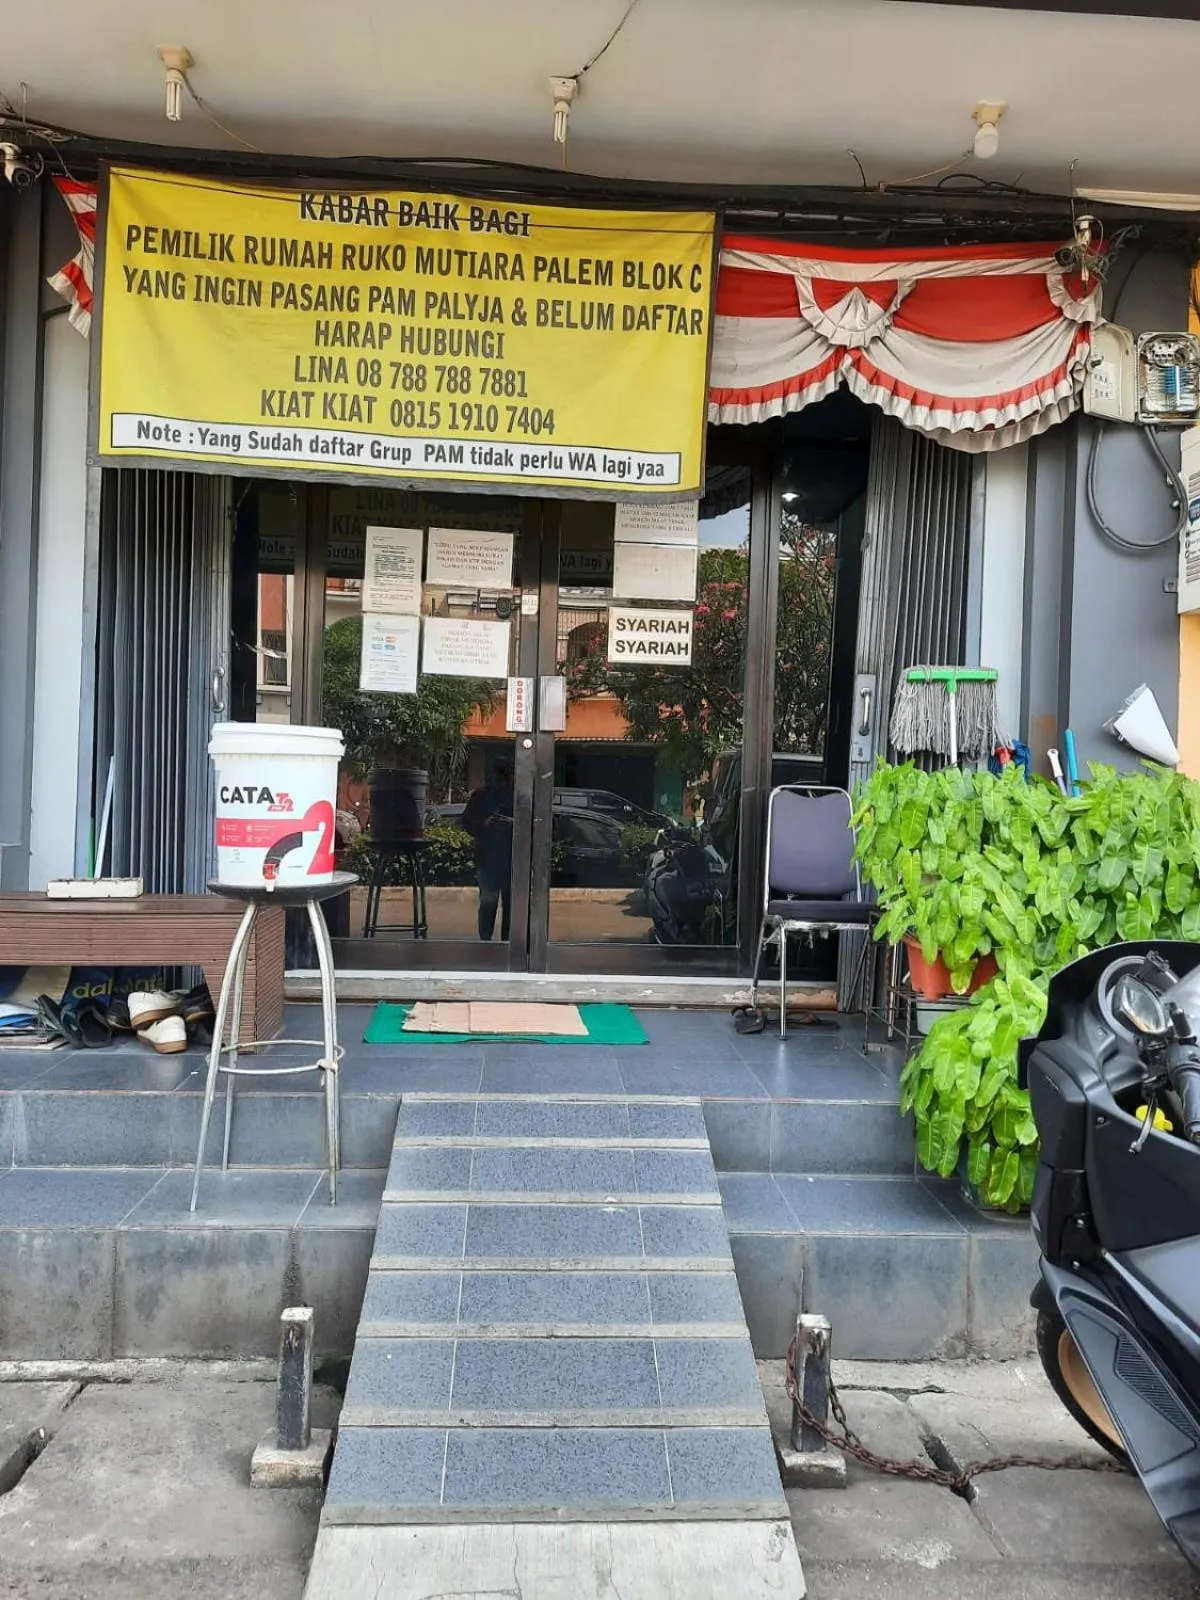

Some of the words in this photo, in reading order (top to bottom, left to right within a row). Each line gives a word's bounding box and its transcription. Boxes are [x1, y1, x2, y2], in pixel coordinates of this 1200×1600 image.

[300, 192, 389, 226] KABAR
[399, 200, 460, 231] BAIK
[470, 207, 530, 237] BAGI
[126, 224, 235, 263] PEMILIK
[244, 235, 332, 269] RUMAH
[341, 243, 406, 272] RUKO
[415, 246, 525, 281] MUTIARA
[534, 255, 613, 286] PALEM
[622, 259, 683, 291] BLOK
[690, 263, 702, 293] C
[123, 265, 186, 300] YANG
[193, 274, 262, 307] INGIN
[270, 282, 359, 312] PASANG
[368, 286, 416, 317] PAM
[425, 291, 504, 323] PALYJA
[511, 297, 527, 327] &
[536, 298, 614, 331] BELUM
[622, 304, 703, 336] DAFTAR
[315, 319, 392, 349] HARAP
[400, 326, 505, 359] HUBUNGI
[294, 355, 349, 385] LINA
[356, 358, 382, 388] 08
[390, 362, 427, 392] 788
[434, 365, 472, 395] 788
[479, 367, 528, 398] 7881
[260, 388, 315, 418] KIAT
[322, 392, 377, 424] KIAT
[390, 398, 441, 430] 0815
[448, 402, 498, 433] 1910
[506, 405, 555, 435] 7404
[137, 420, 182, 442] Note
[248, 431, 302, 453] Sudah
[309, 435, 364, 458] daftar
[370, 440, 412, 465] Grup
[424, 443, 464, 465] PAM
[470, 445, 514, 467] tidak
[520, 451, 563, 472] perlu
[568, 452, 596, 473] WA
[602, 454, 632, 478] lagi
[637, 463, 664, 480] yaa
[615, 639, 689, 656] SYARIAH
[616, 617, 689, 634] SYARIAH
